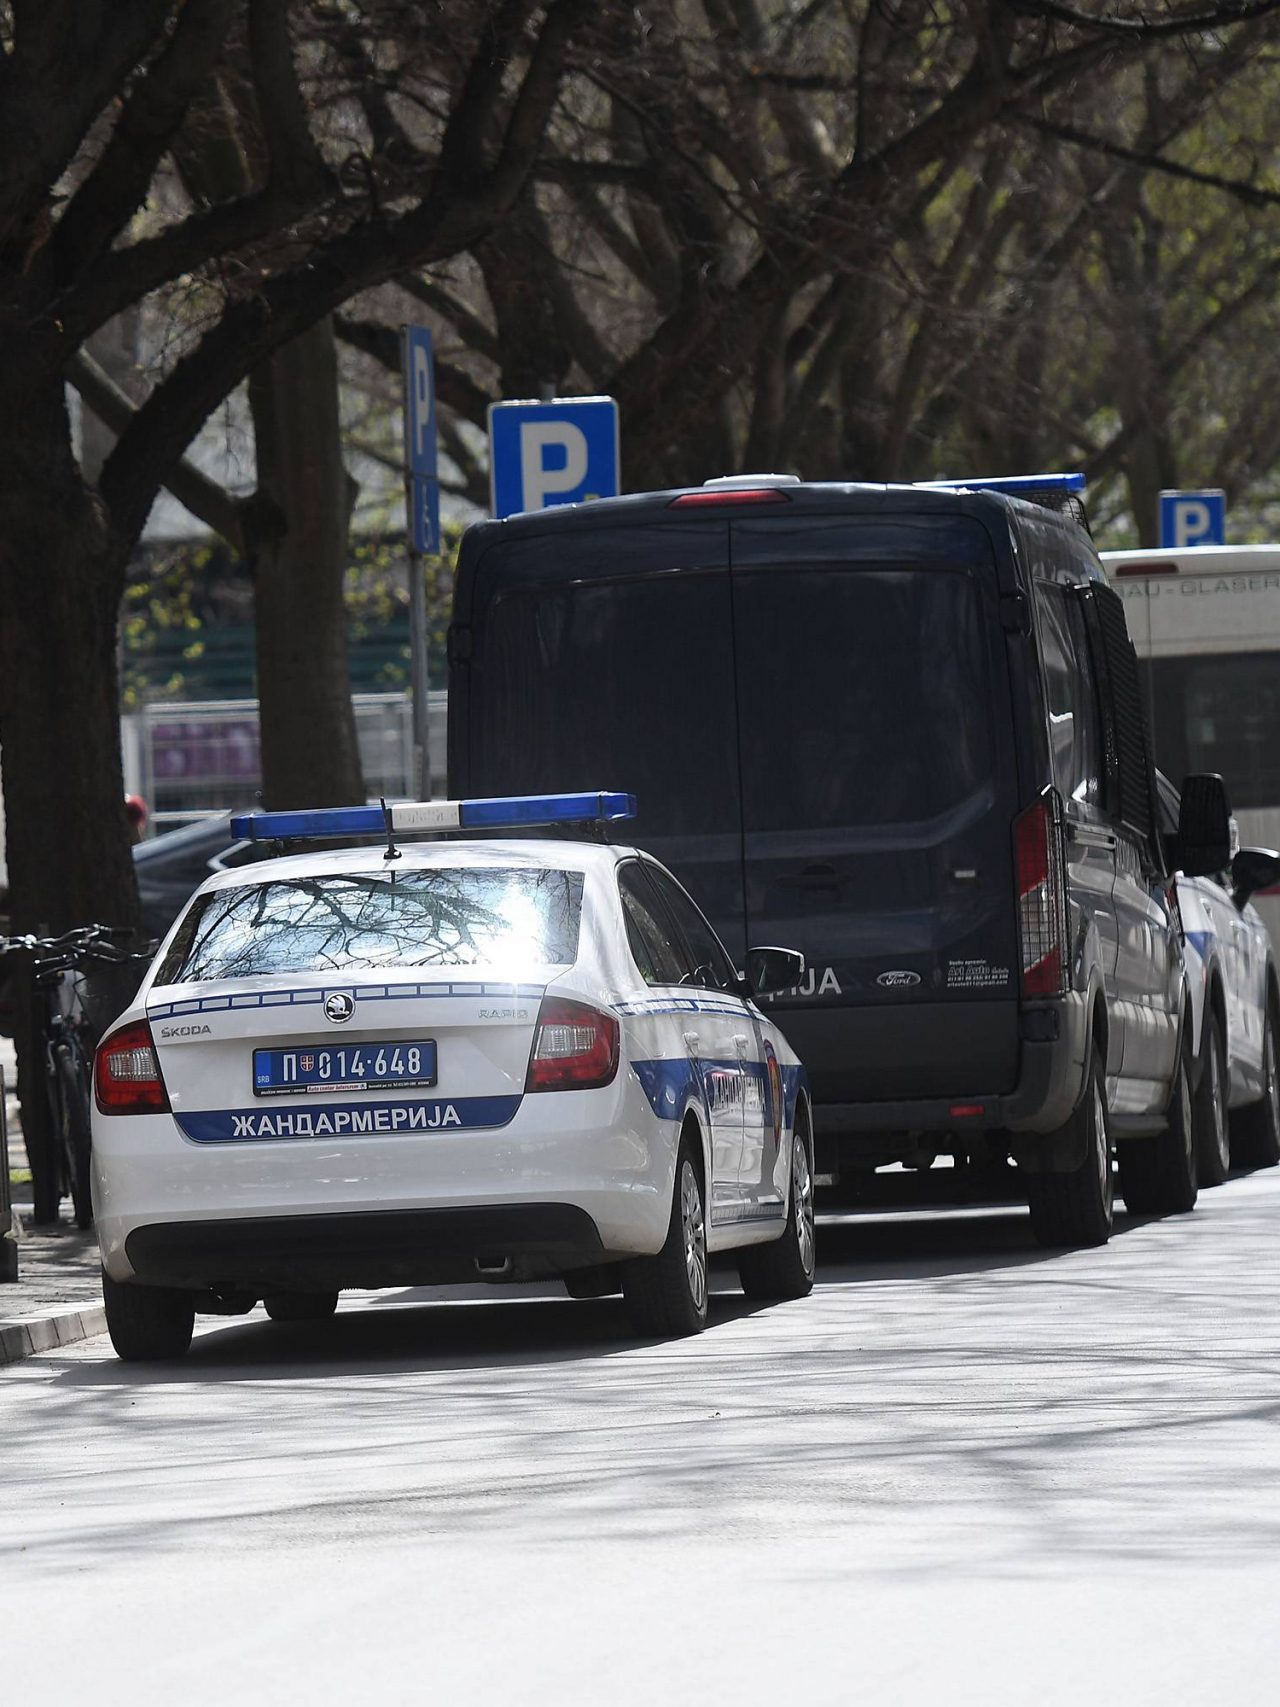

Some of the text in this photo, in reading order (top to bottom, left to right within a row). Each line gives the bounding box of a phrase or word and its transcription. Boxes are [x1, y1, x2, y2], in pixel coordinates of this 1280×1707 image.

[521, 420, 588, 513] P
[1174, 501, 1211, 547] P
[161, 1025, 211, 1038] ŠKODA
[283, 1054, 297, 1081] П
[232, 1105, 461, 1137] ЖАНДАРМЕРИЈА
